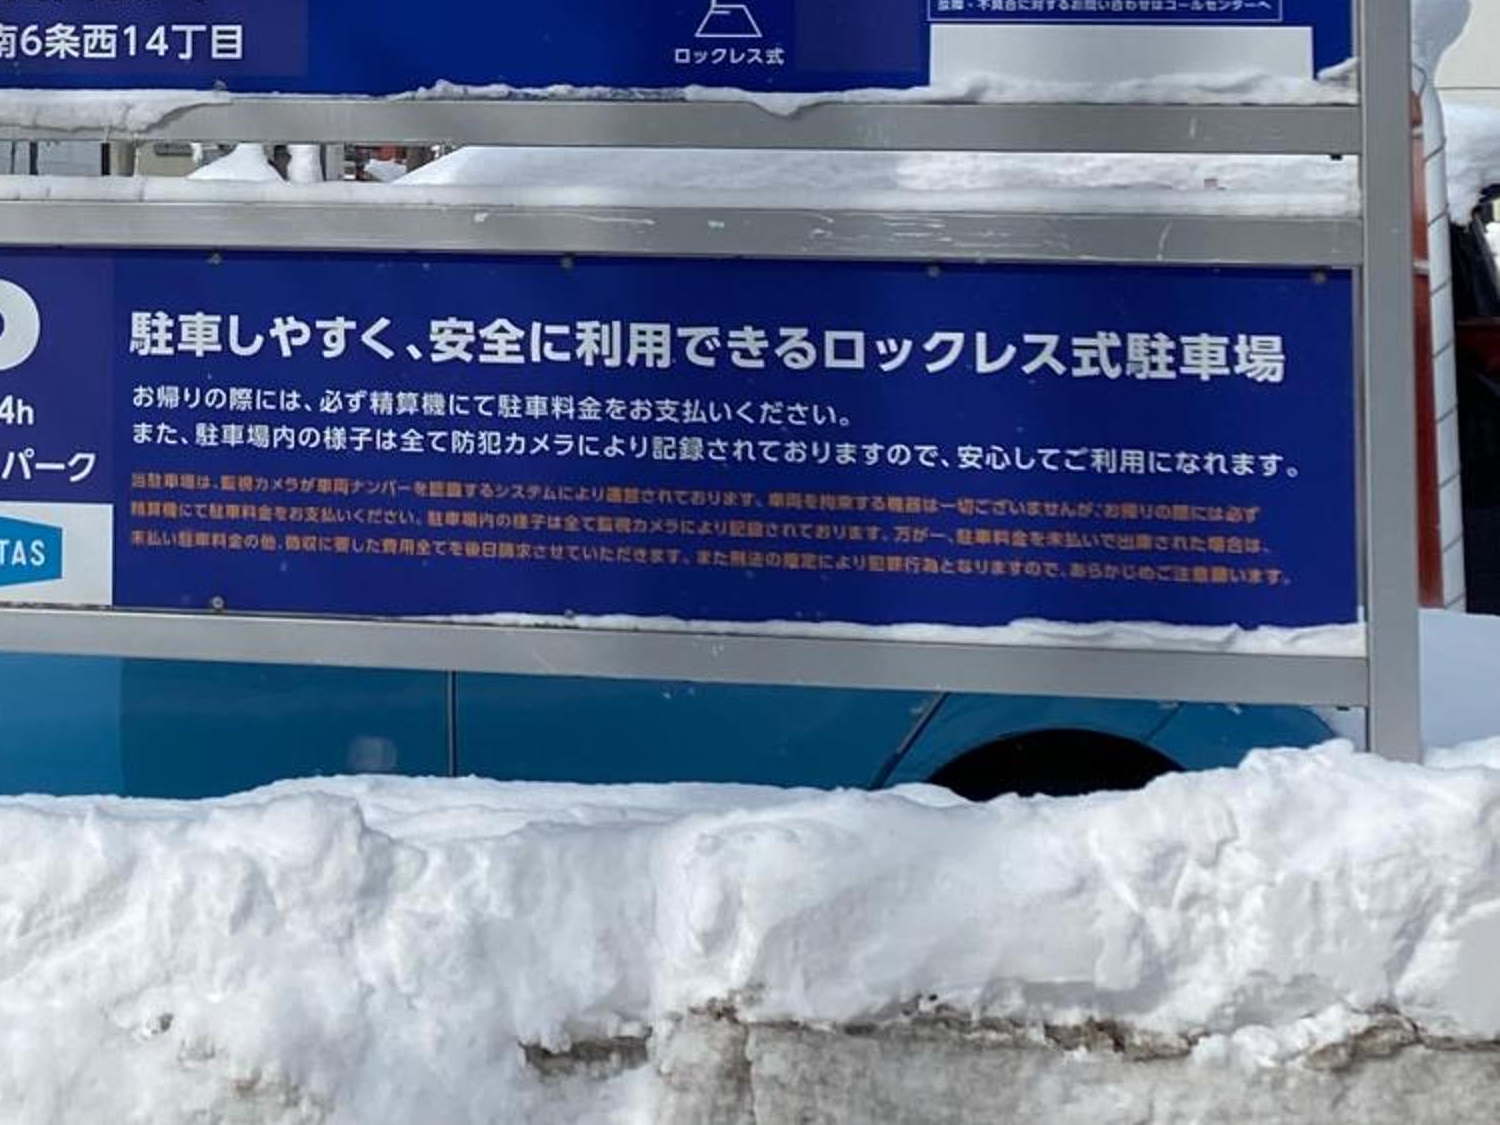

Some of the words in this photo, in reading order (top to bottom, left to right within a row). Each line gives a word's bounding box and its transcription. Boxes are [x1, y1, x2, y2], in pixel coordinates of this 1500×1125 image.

[674, 46, 786, 66] ロックレス式
[129, 311, 1286, 383] 駐車しやすく、安全に利用できるロックレス式駐車場
[131, 385, 850, 427] お帰りの際には、必ず精算機にて駐車料金をお支払いください。
